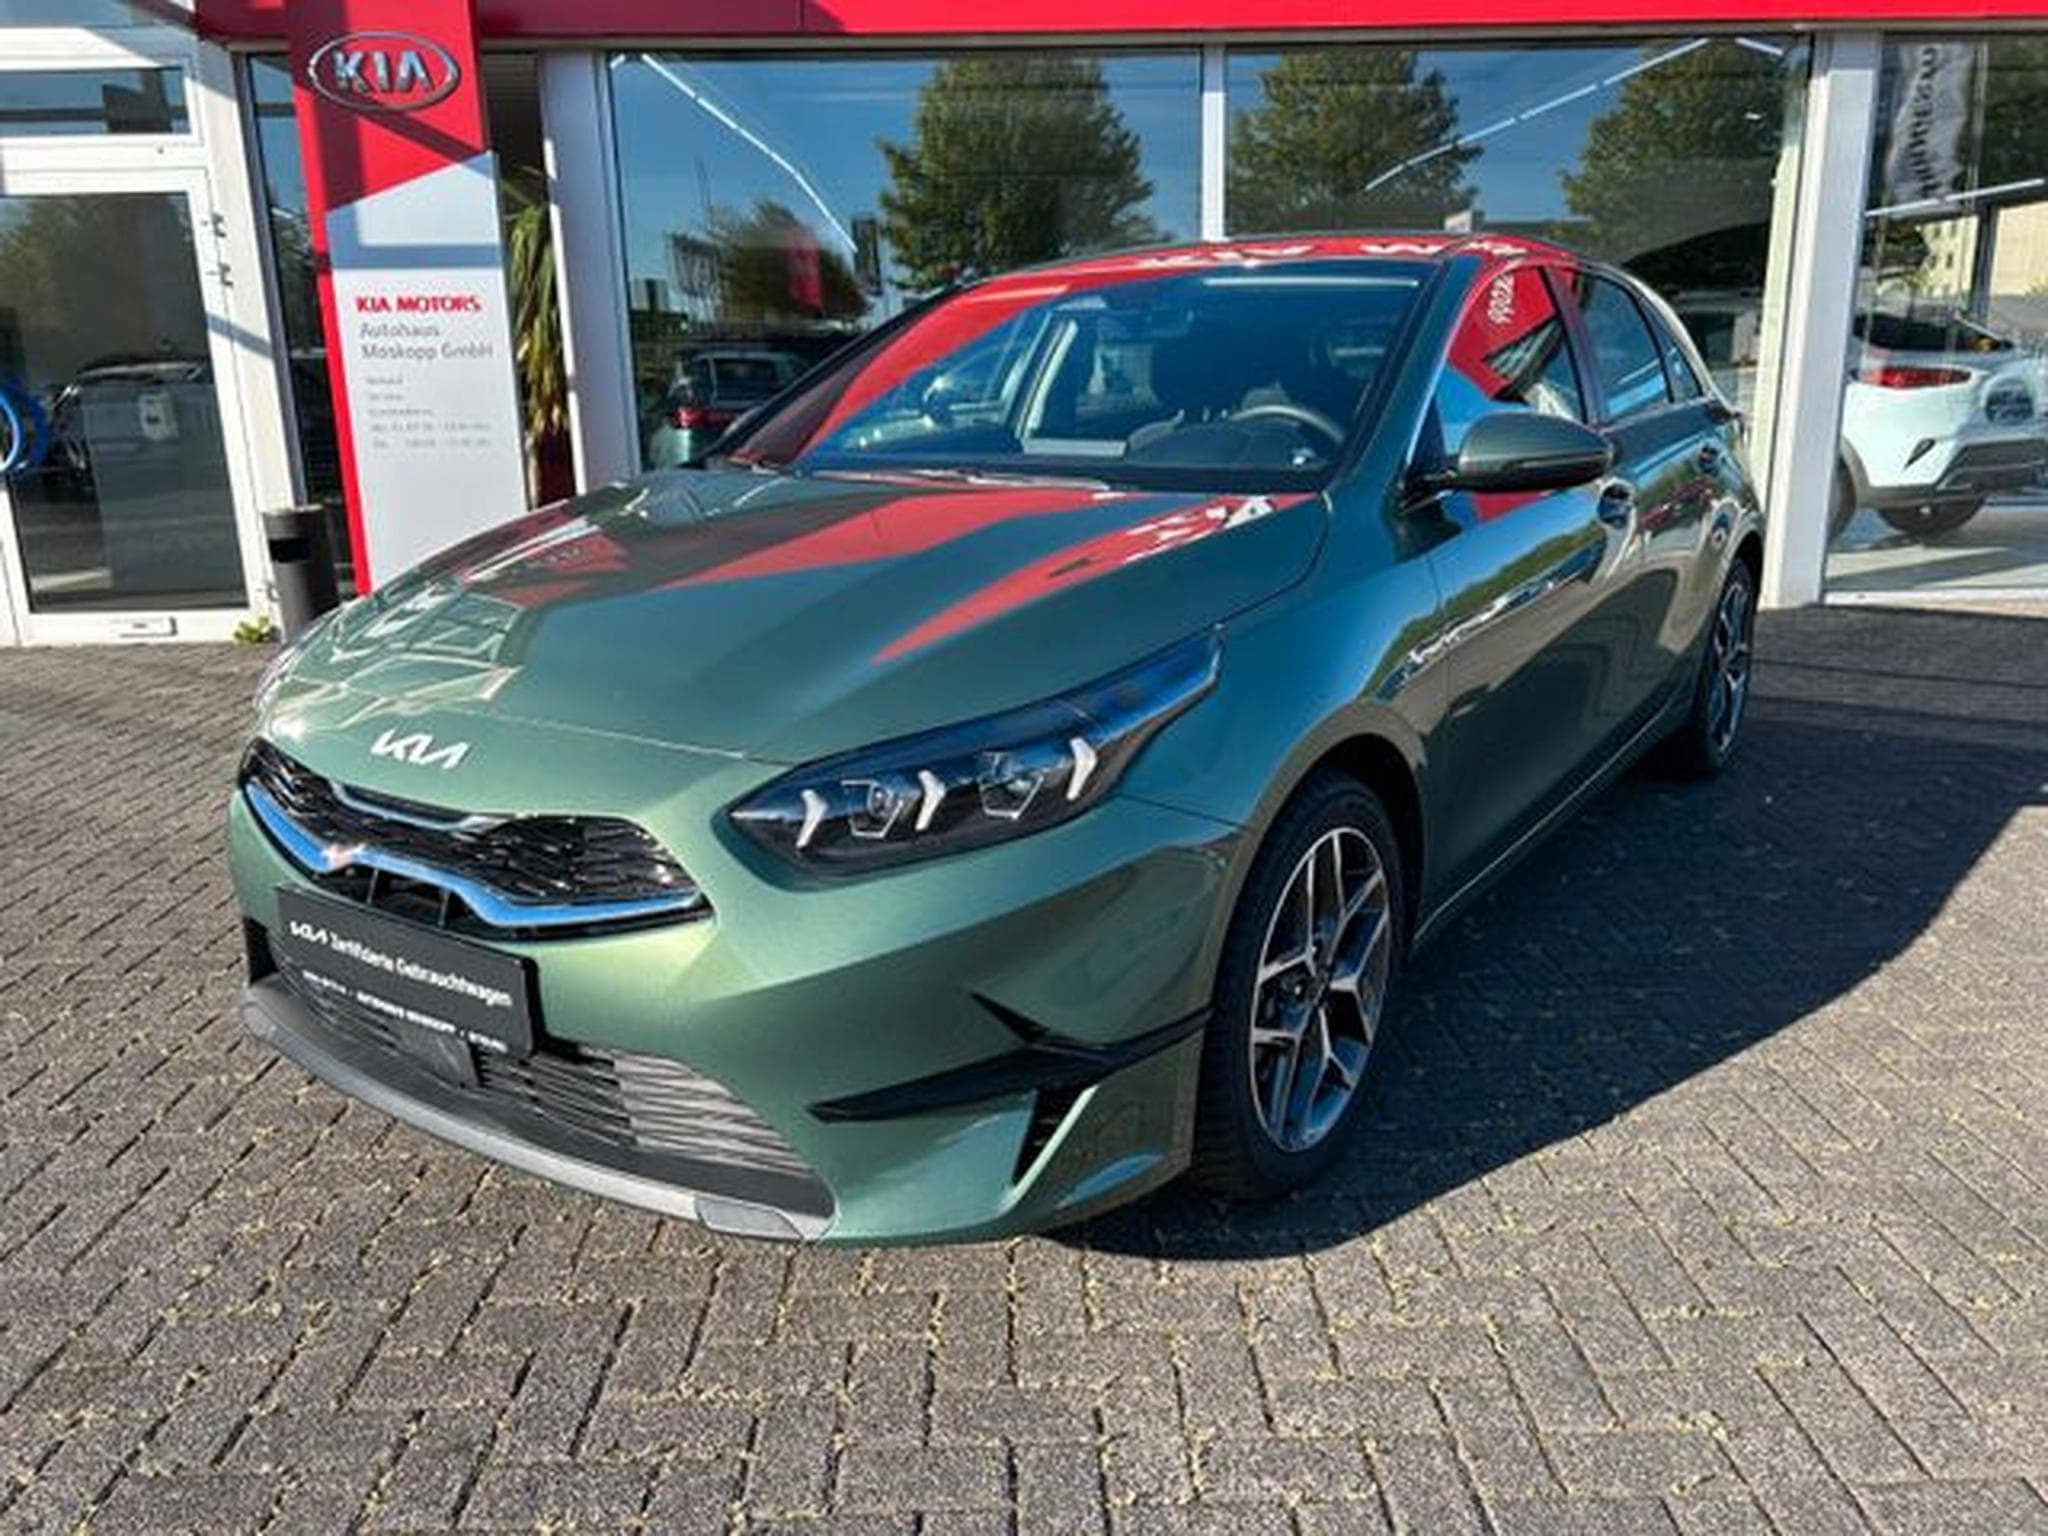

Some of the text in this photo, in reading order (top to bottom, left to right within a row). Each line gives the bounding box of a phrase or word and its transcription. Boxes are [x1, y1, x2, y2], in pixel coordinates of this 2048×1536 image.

[332, 50, 435, 93] KIA
[356, 295, 482, 313] KIA MOTORS
[360, 322, 440, 338] Autohaus
[441, 341, 494, 360] GmbH
